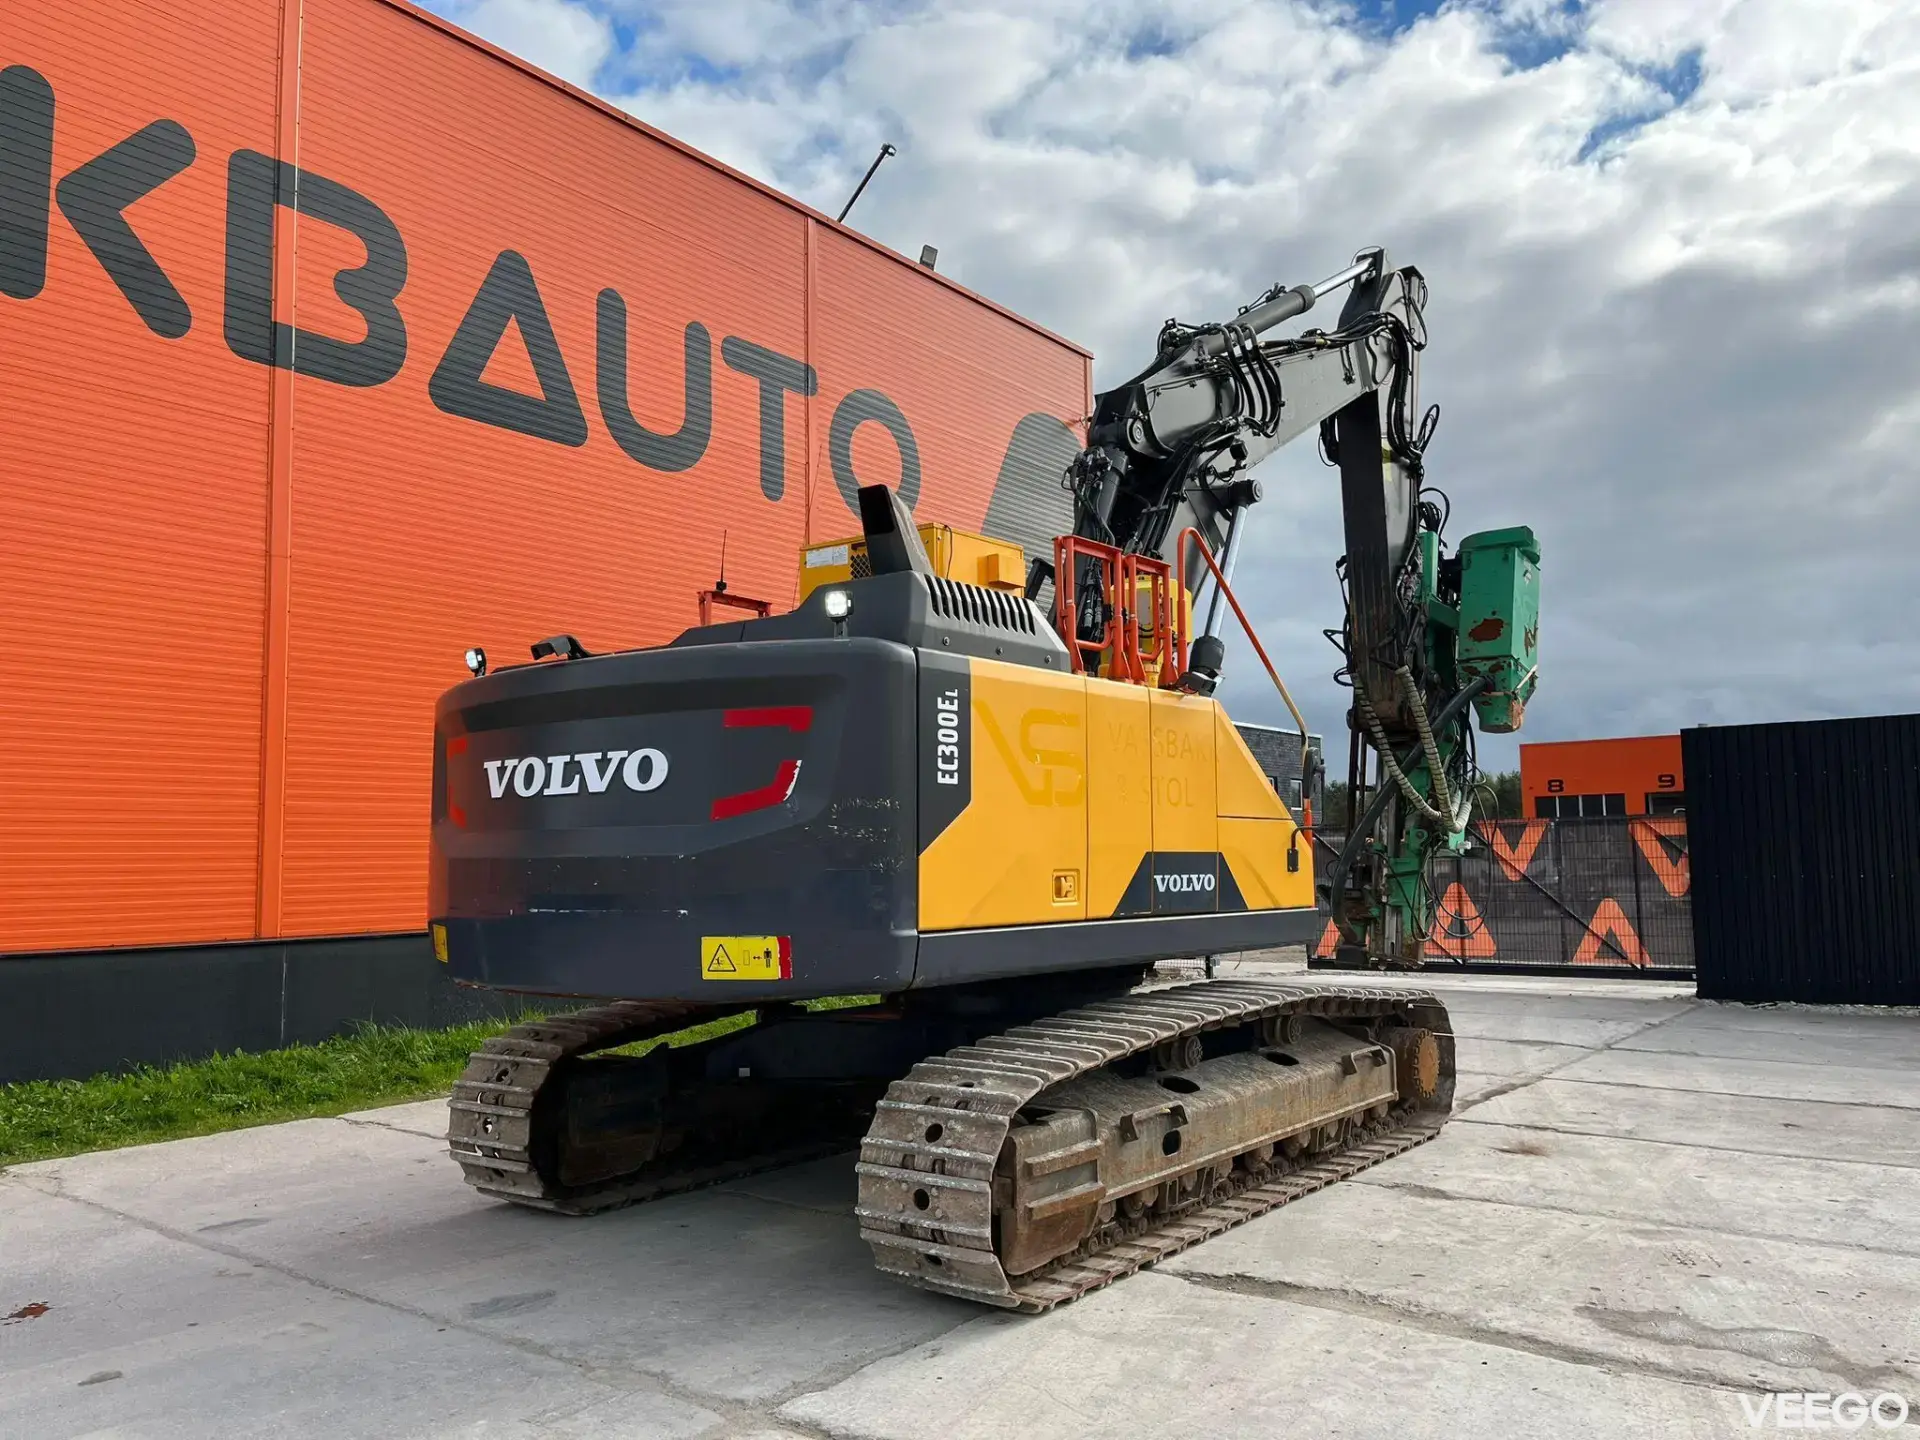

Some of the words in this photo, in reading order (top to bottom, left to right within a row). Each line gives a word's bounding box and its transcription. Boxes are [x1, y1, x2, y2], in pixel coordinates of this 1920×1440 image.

[483, 747, 669, 799] VOLVO
[1658, 774, 1675, 788] 9
[1547, 779, 1564, 793] 8
[1153, 873, 1216, 893] VOLVO
